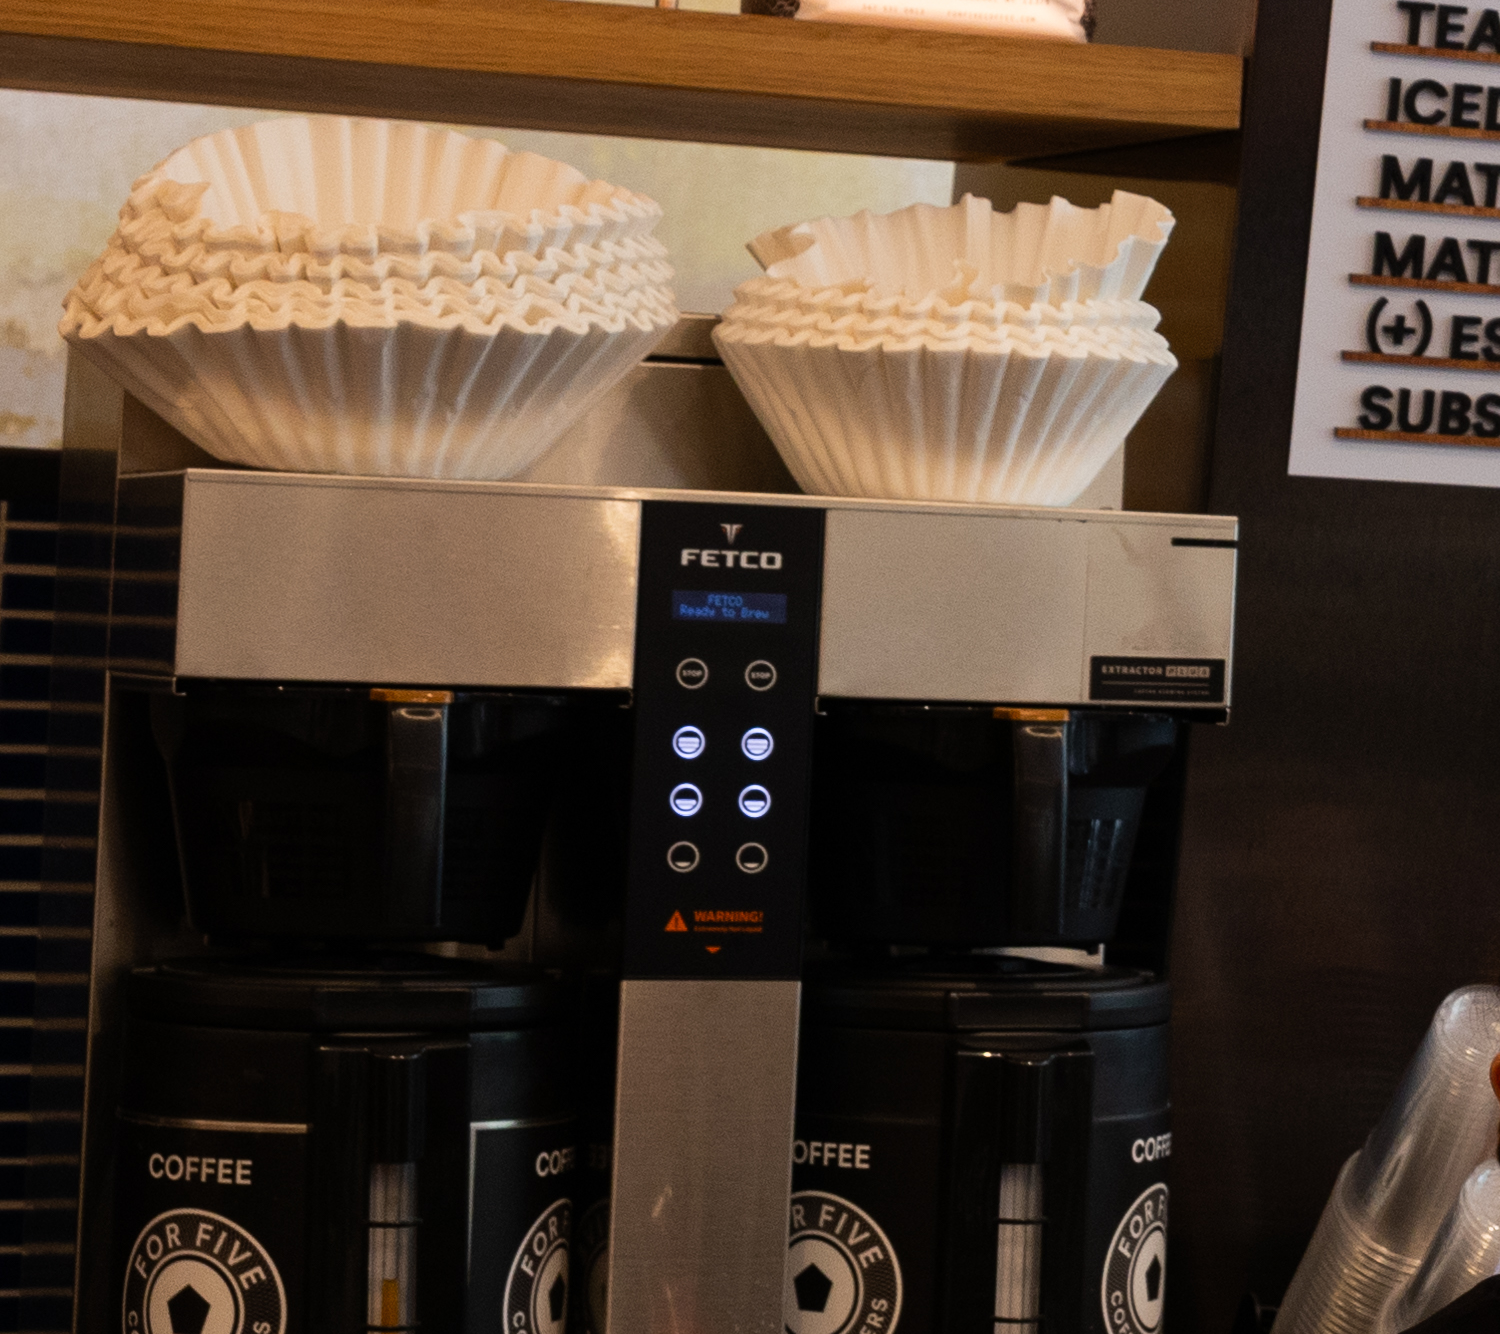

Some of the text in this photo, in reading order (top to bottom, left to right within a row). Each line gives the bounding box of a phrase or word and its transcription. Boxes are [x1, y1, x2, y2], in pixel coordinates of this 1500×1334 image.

[1364, 296, 1435, 360] (+)
[680, 548, 783, 570] FETCO
[679, 604, 715, 618] Ready
[740, 607, 770, 619] Brew
[707, 594, 743, 607] FETCO
[694, 910, 764, 923] WARNING!
[148, 1153, 253, 1185] COFFEE
[134, 1223, 267, 1290] FOR FIVE
